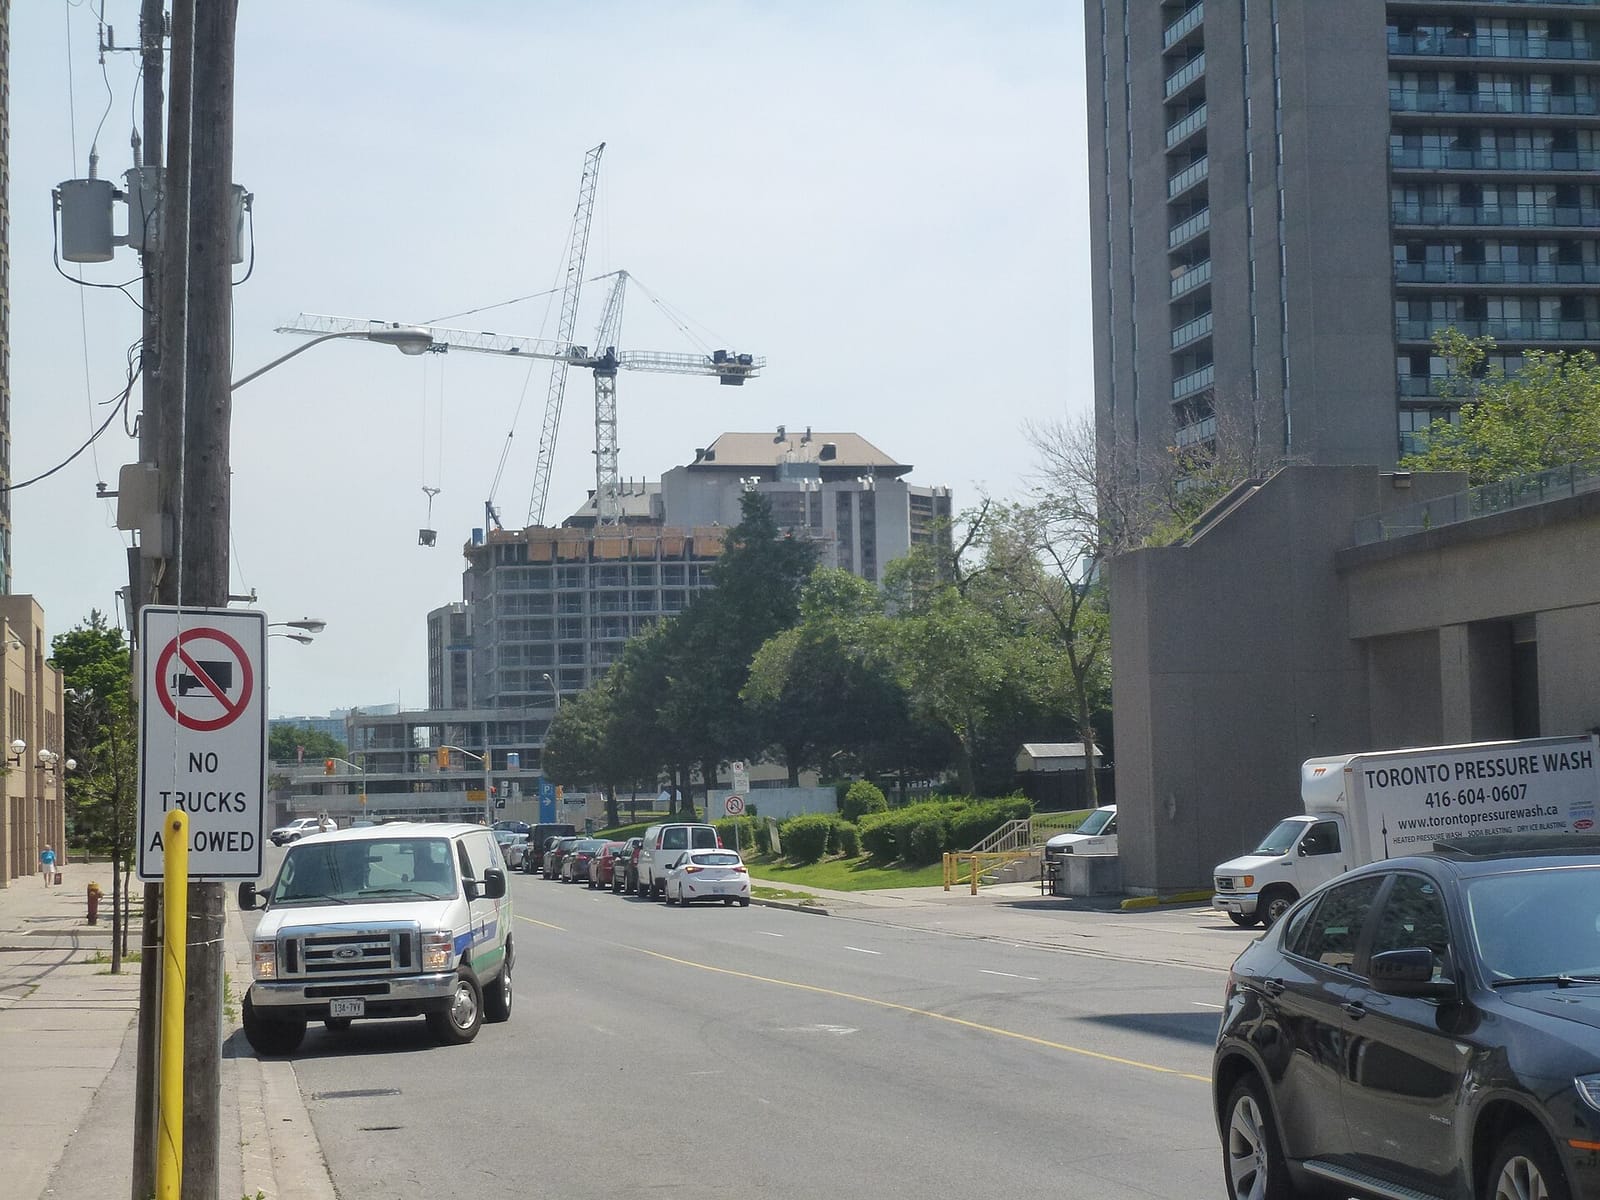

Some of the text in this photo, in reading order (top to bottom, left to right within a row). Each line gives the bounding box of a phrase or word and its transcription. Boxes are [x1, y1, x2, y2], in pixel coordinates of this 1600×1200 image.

[189, 752, 218, 773] NO
[1365, 750, 1593, 788] TORONTO PRESSURE WASH
[159, 791, 246, 813] TRUCKS
[1425, 784, 1528, 808] 416-604-0607
[1398, 805, 1557, 829] www.torontopressurewash.ca
[149, 831, 254, 852] AOWED
[1393, 835, 1415, 844] HEATED
[1416, 832, 1444, 842] PRESSURE
[1446, 831, 1463, 840] WASH
[1484, 826, 1512, 836] BLASTING
[1516, 825, 1528, 833] DRY
[1529, 823, 1539, 831] ICE
[1540, 820, 1567, 830] BLASTING
